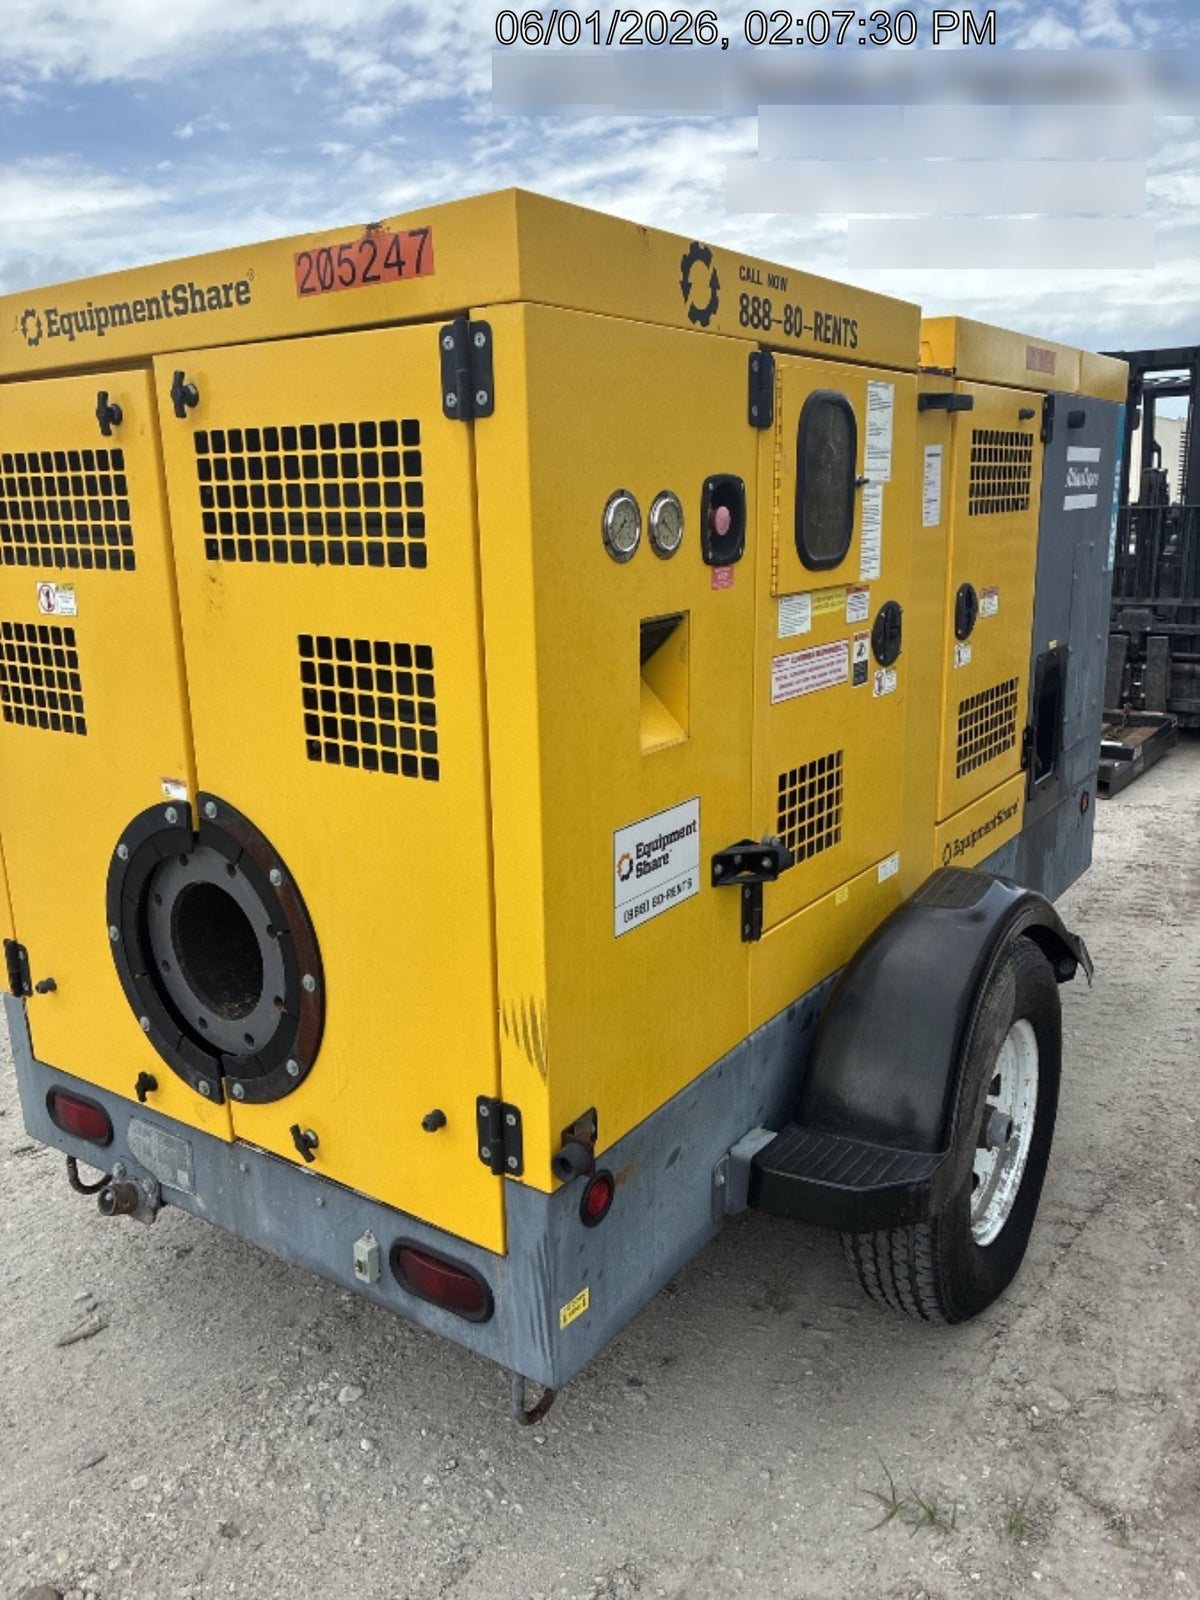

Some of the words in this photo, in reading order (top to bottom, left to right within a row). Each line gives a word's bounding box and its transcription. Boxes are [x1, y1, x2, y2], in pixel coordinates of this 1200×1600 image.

[297, 228, 429, 294] 205247
[739, 265, 763, 285] CALL
[767, 273, 788, 292] NOW
[47, 279, 251, 341] EquipmentShare
[739, 293, 858, 349] 888-80-RENTS
[635, 819, 697, 859] Equipment
[635, 852, 669, 879] Share
